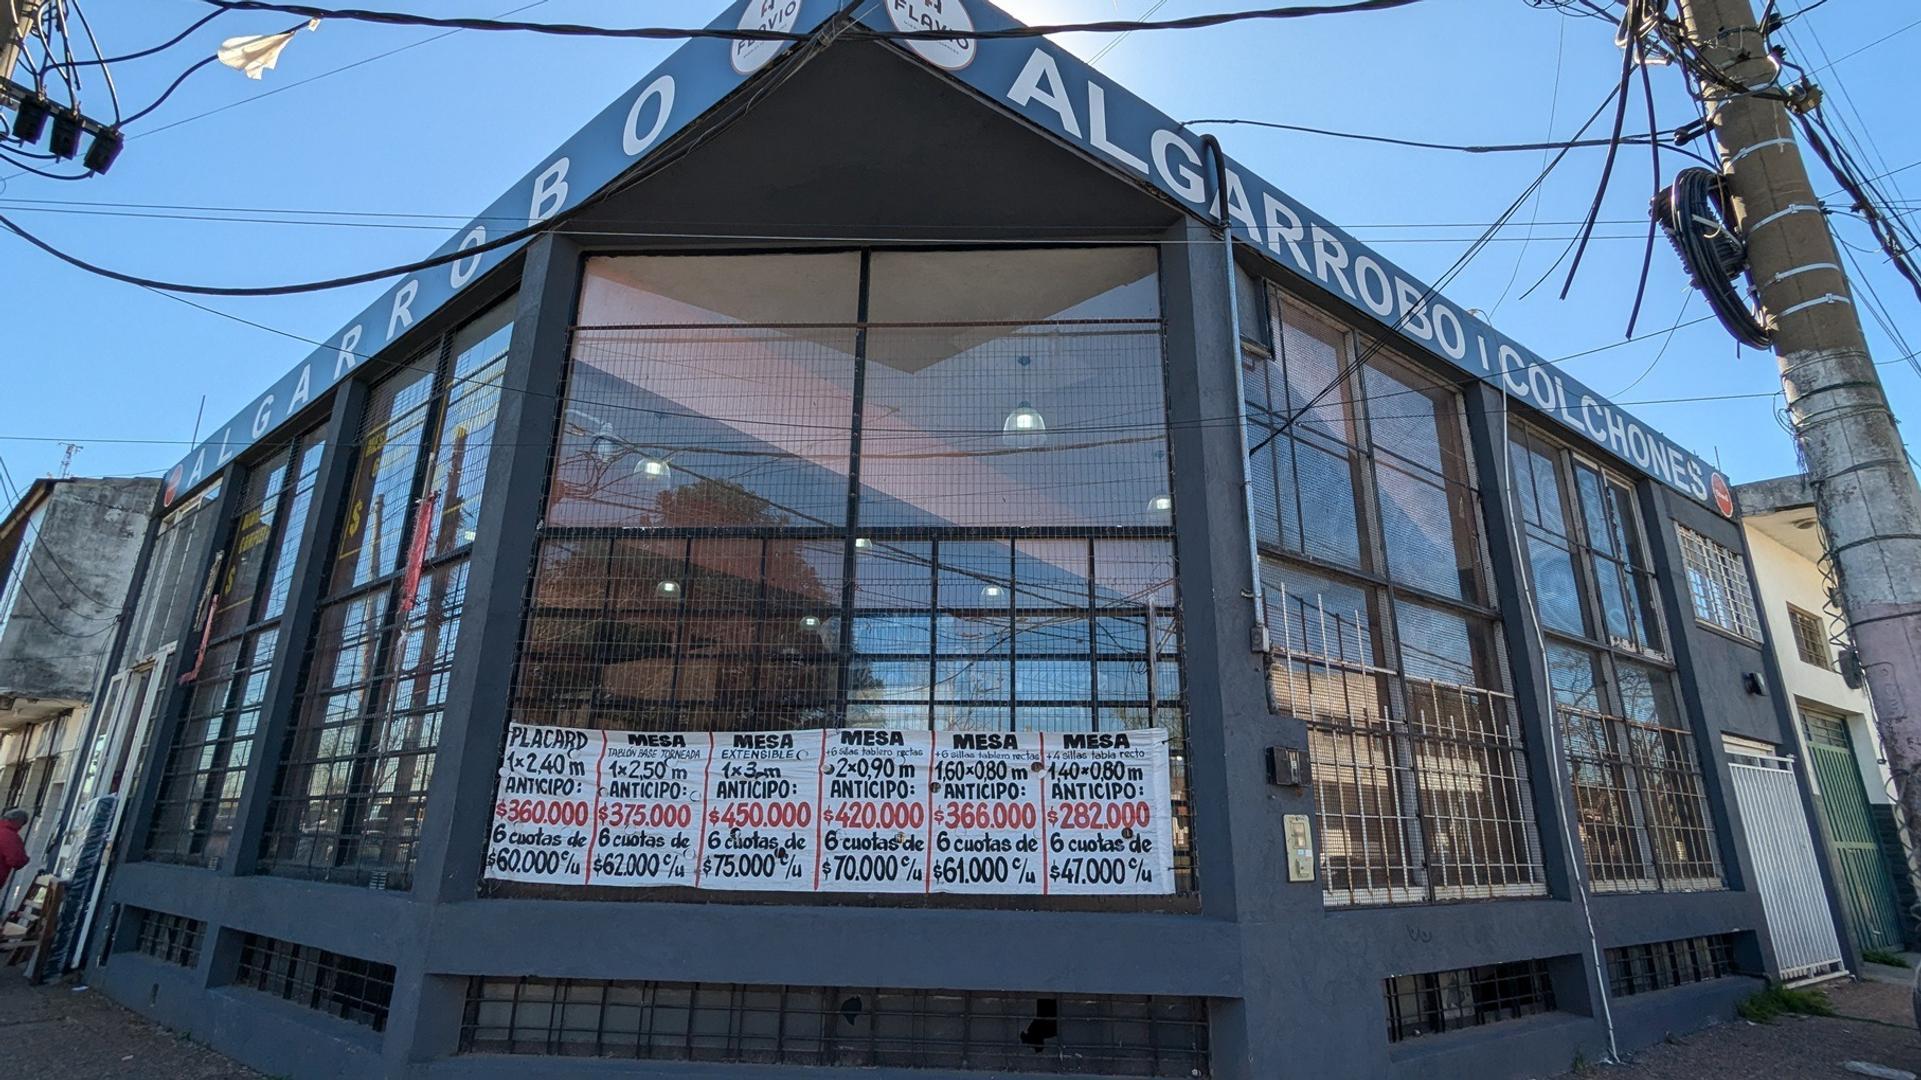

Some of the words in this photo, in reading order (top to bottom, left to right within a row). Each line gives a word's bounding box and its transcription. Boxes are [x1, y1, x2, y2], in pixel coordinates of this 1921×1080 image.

[186, 75, 675, 489] ALGARROBO
[1006, 47, 1465, 360] ALGARROBO
[1499, 344, 1708, 501] COLCHONES
[509, 727, 588, 750] PLACARD
[628, 734, 687, 748] MESA
[733, 734, 793, 749] MESA
[841, 731, 904, 746] MESA
[953, 734, 1018, 750] MESA
[1063, 733, 1130, 749] MESA
[638, 749, 658, 758] BASE
[661, 749, 700, 760] TORNEADA
[721, 749, 794, 759] EXTENSIBLE
[951, 750, 975, 759] sillas
[978, 751, 1010, 760] tablero
[1012, 750, 1040, 760] rectas
[1062, 750, 1087, 760] sillas
[1120, 748, 1145, 759] recto
[504, 778, 582, 796] ANTICIPO:
[610, 782, 688, 799] ANTICIPO:
[717, 780, 798, 799] ANTICIPO:
[830, 780, 915, 799] ANTICIPO:
[944, 782, 1027, 800] ANTICIPO:
[1052, 782, 1144, 800] ANTICIPO:
[496, 800, 589, 827] $360.000
[598, 802, 691, 828] $375.000
[709, 802, 811, 828] $450.000
[823, 802, 924, 829] $420.000
[934, 802, 1036, 829] $366.000
[1047, 801, 1150, 829] $282.000
[493, 824, 506, 844] 6
[508, 827, 561, 846] cuotas
[566, 831, 588, 848] de
[599, 826, 611, 847] 6
[613, 829, 665, 848] cuotas
[668, 832, 690, 848] de
[708, 830, 721, 849] 6
[726, 830, 778, 850] cuotas
[785, 832, 806, 850] de
[825, 831, 837, 849] 6
[842, 832, 898, 851] cuotas
[905, 832, 924, 851] de
[936, 832, 949, 850] 6
[953, 832, 1012, 852] cuotas
[1016, 834, 1038, 852] de
[1050, 833, 1063, 852] 6
[1068, 834, 1126, 852] cuotas
[1130, 835, 1152, 853] de
